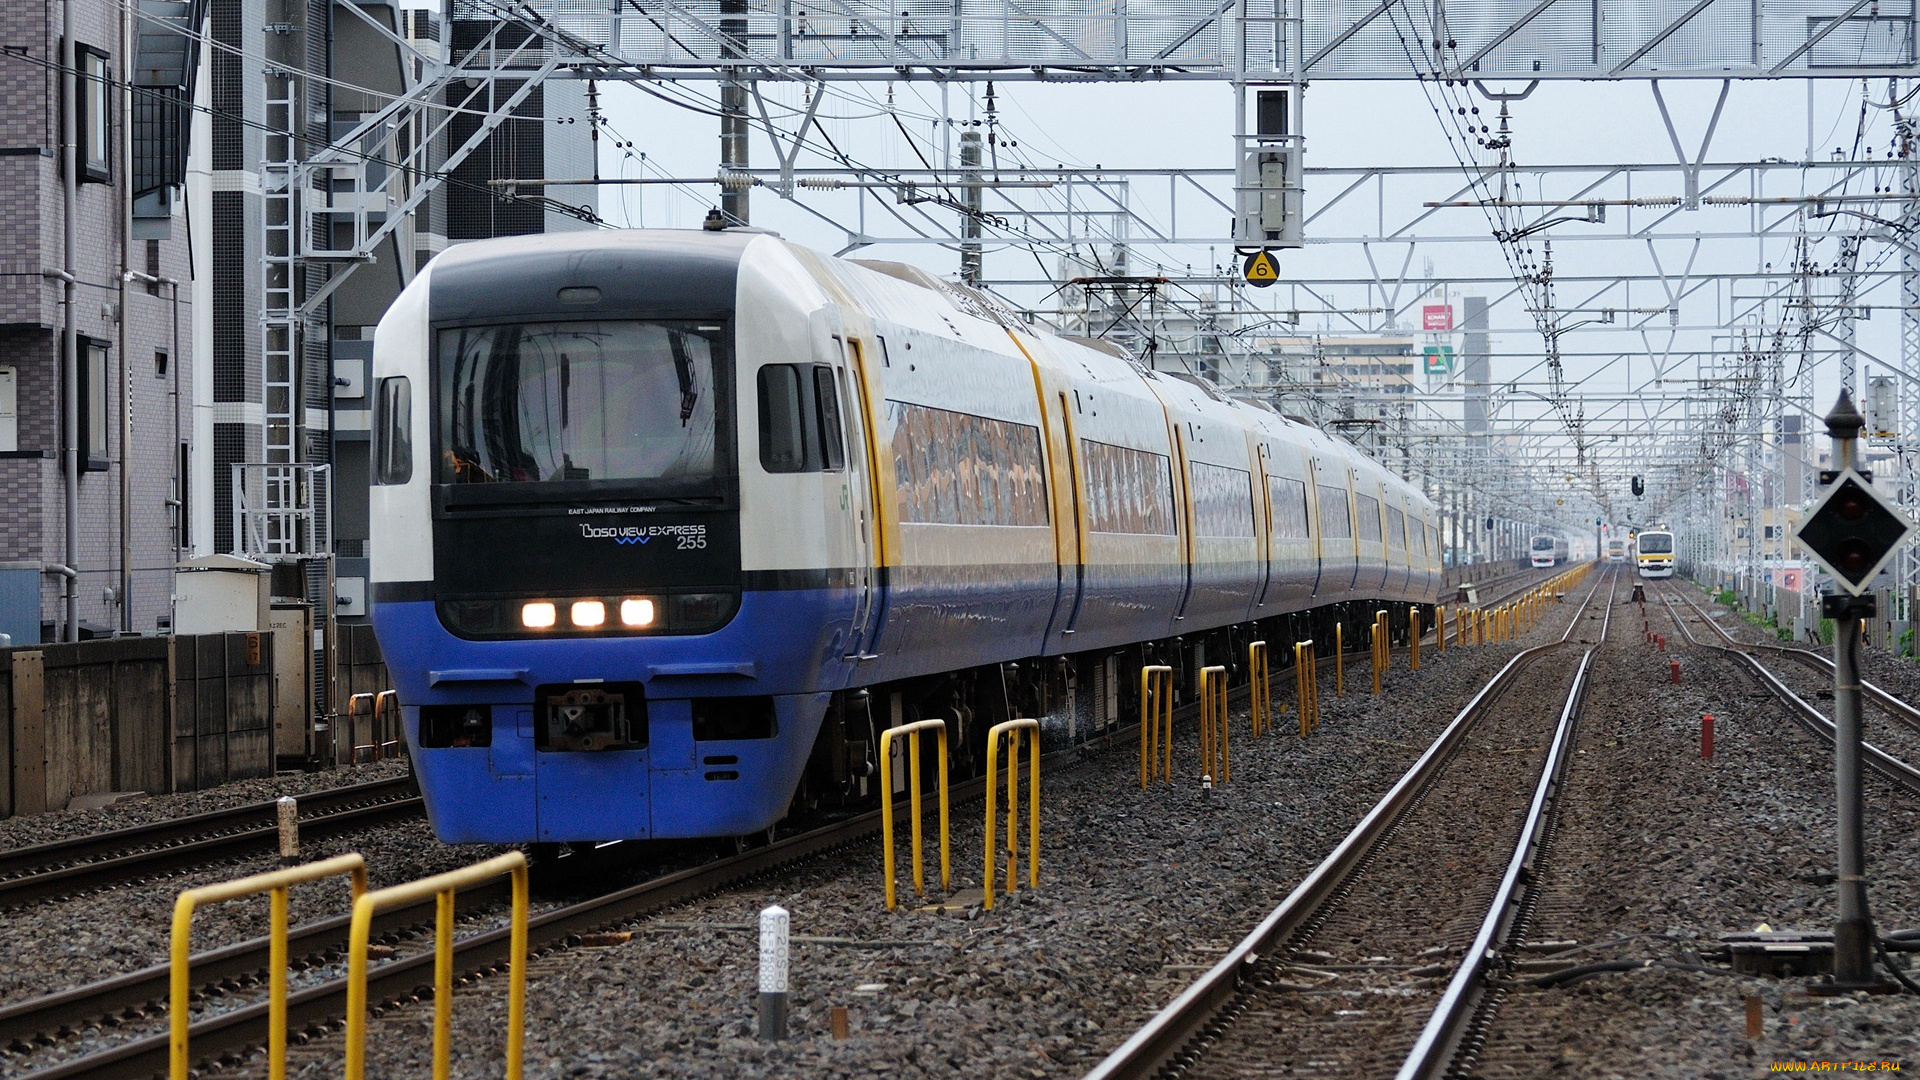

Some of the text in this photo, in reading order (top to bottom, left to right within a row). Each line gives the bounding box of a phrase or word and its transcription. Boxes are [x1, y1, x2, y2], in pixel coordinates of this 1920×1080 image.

[1256, 263, 1268, 276] 6
[839, 484, 850, 510] JR
[618, 526, 647, 537] VIEW
[648, 525, 706, 536] EXPRESS
[677, 535, 707, 550] 255
